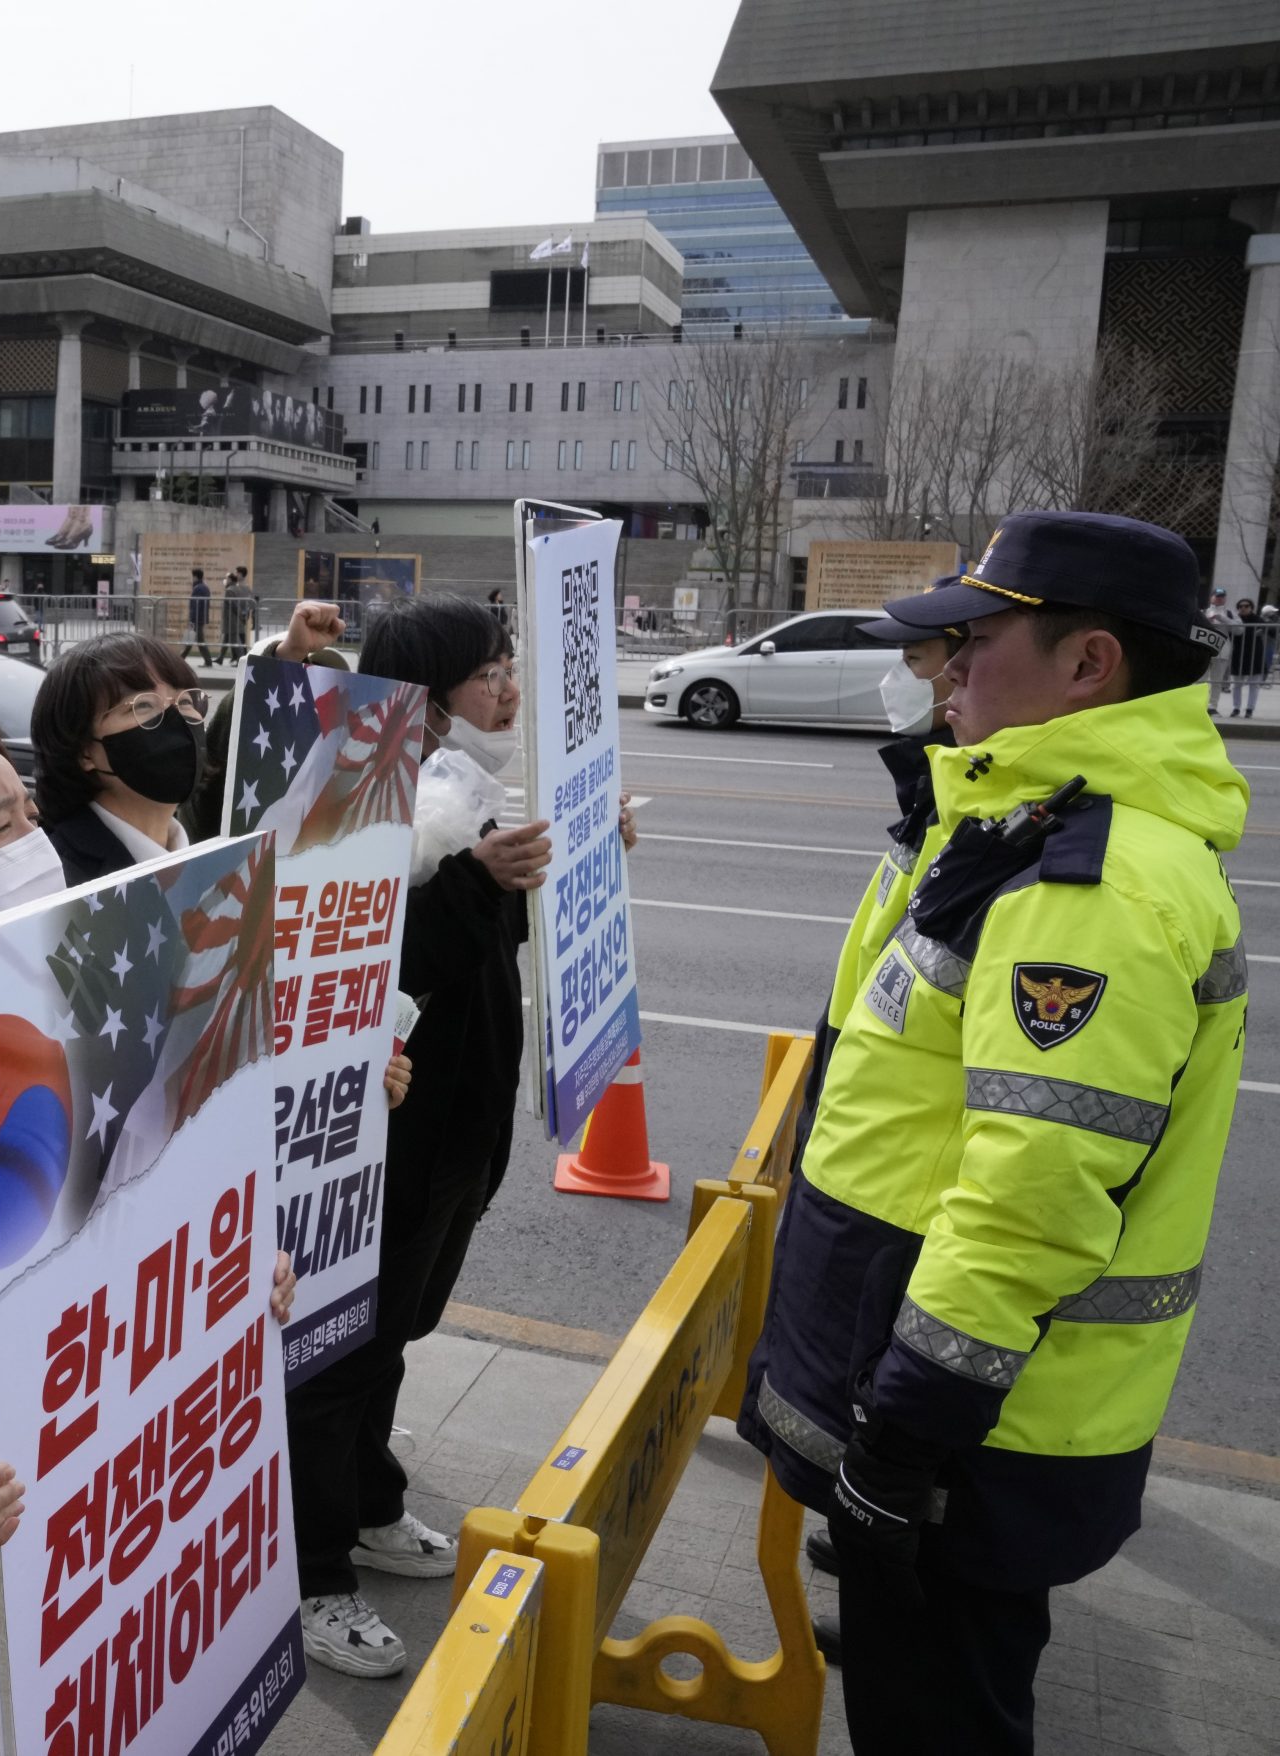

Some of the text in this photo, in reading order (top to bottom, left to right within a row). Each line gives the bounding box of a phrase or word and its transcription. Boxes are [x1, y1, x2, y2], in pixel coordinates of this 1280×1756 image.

[554, 745, 614, 823] 윤석열을 끌어내려
[568, 791, 608, 855] 전쟁을 막자!
[274, 877, 401, 961] 국·일본의
[556, 825, 622, 959] 전쟁반대
[302, 960, 392, 1048] 돌격대
[560, 903, 628, 1047] 평화선언
[876, 956, 910, 1004] 경찰
[1030, 1020, 1066, 1032] POLICE
[37, 1169, 257, 1482] 한·미·일
[283, 1297, 369, 1371] 통일민족위원회
[39, 1312, 265, 1668] 전쟁동맹
[212, 1642, 294, 1756] 민족위원회
